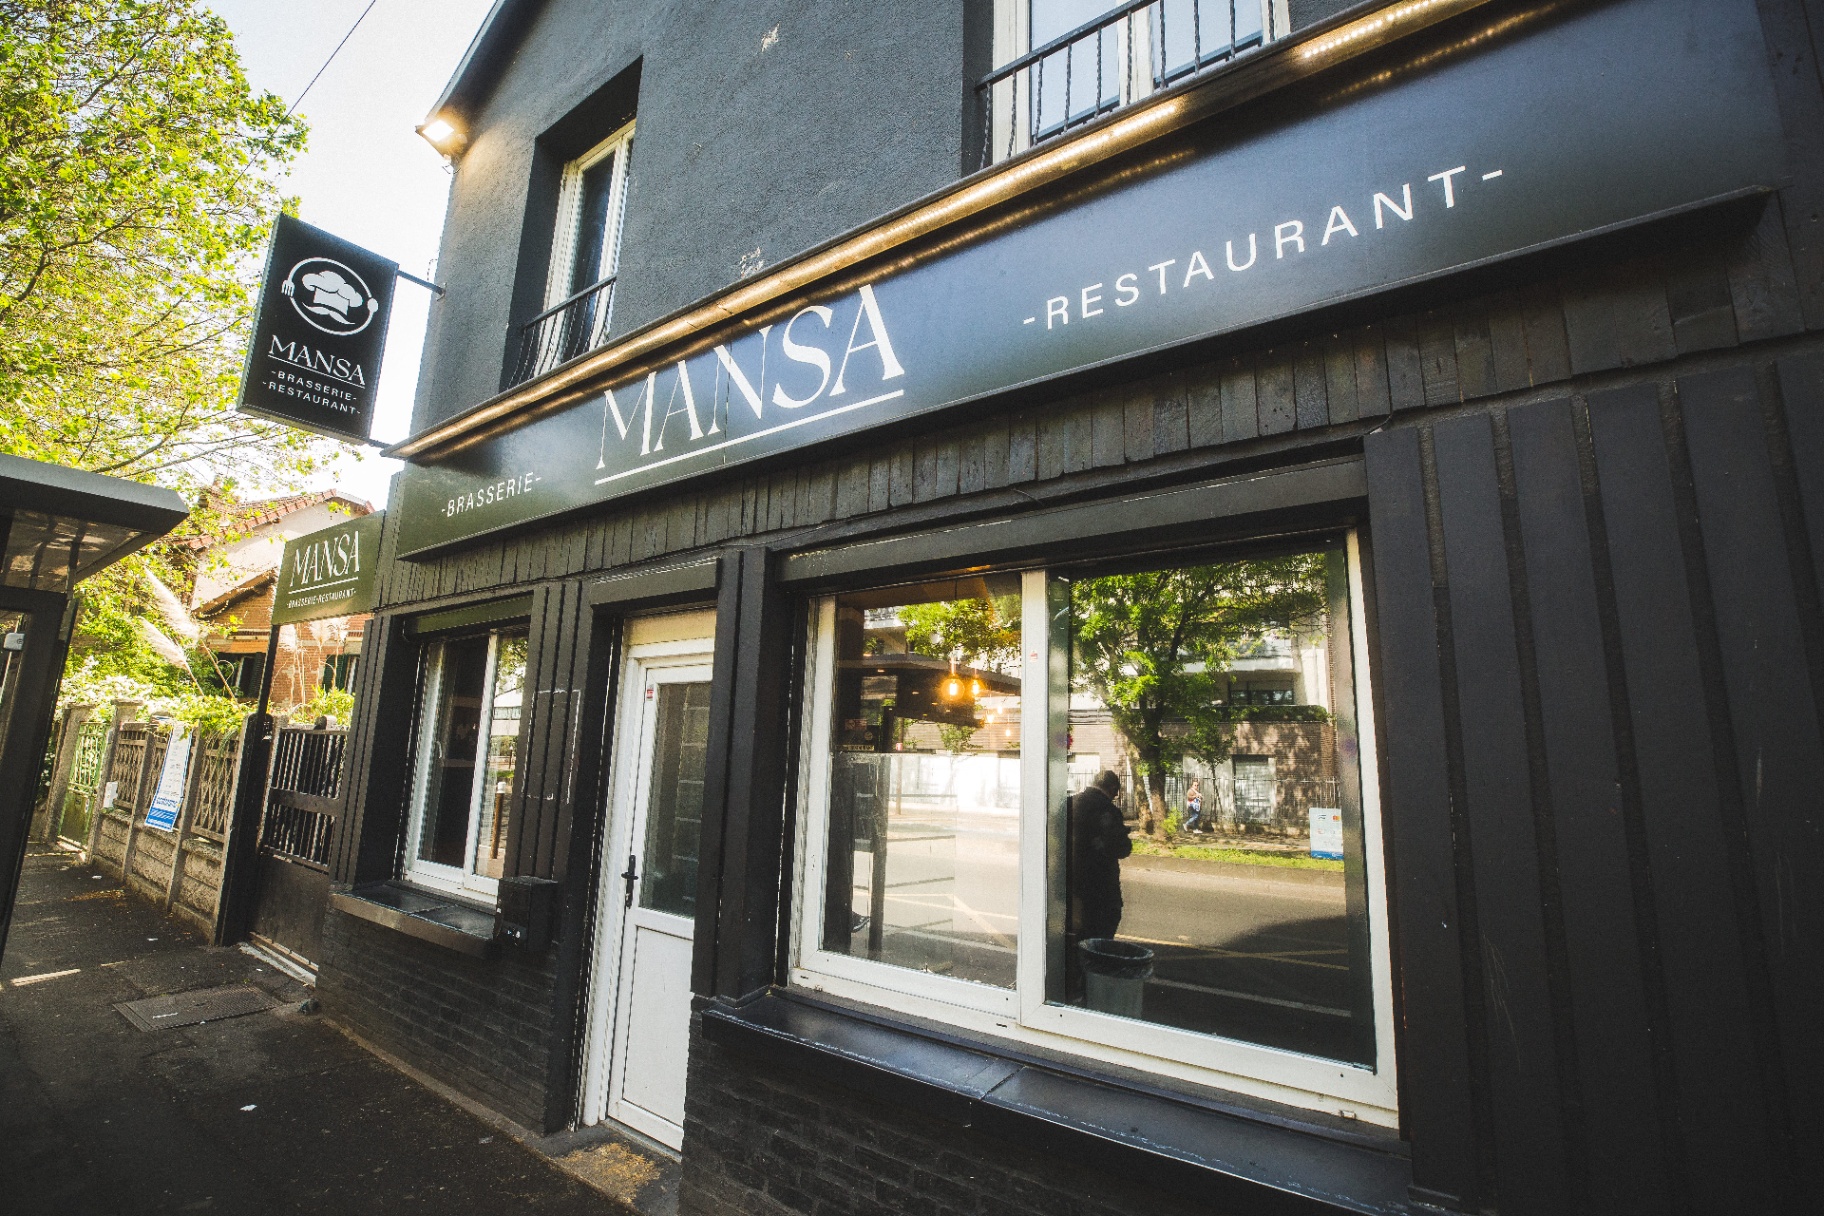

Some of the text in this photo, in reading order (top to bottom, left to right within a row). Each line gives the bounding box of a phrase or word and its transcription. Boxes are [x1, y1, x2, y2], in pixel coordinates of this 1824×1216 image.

[1023, 165, 1503, 330] -RESTAURANT-
[268, 334, 366, 386] MANSA
[271, 370, 357, 401] -BRASSERIE-
[595, 283, 905, 470] MANSA
[262, 381, 361, 414] -RESTAURANT-
[441, 471, 542, 518] -BRASSERIE-
[289, 530, 360, 587] MANSA
